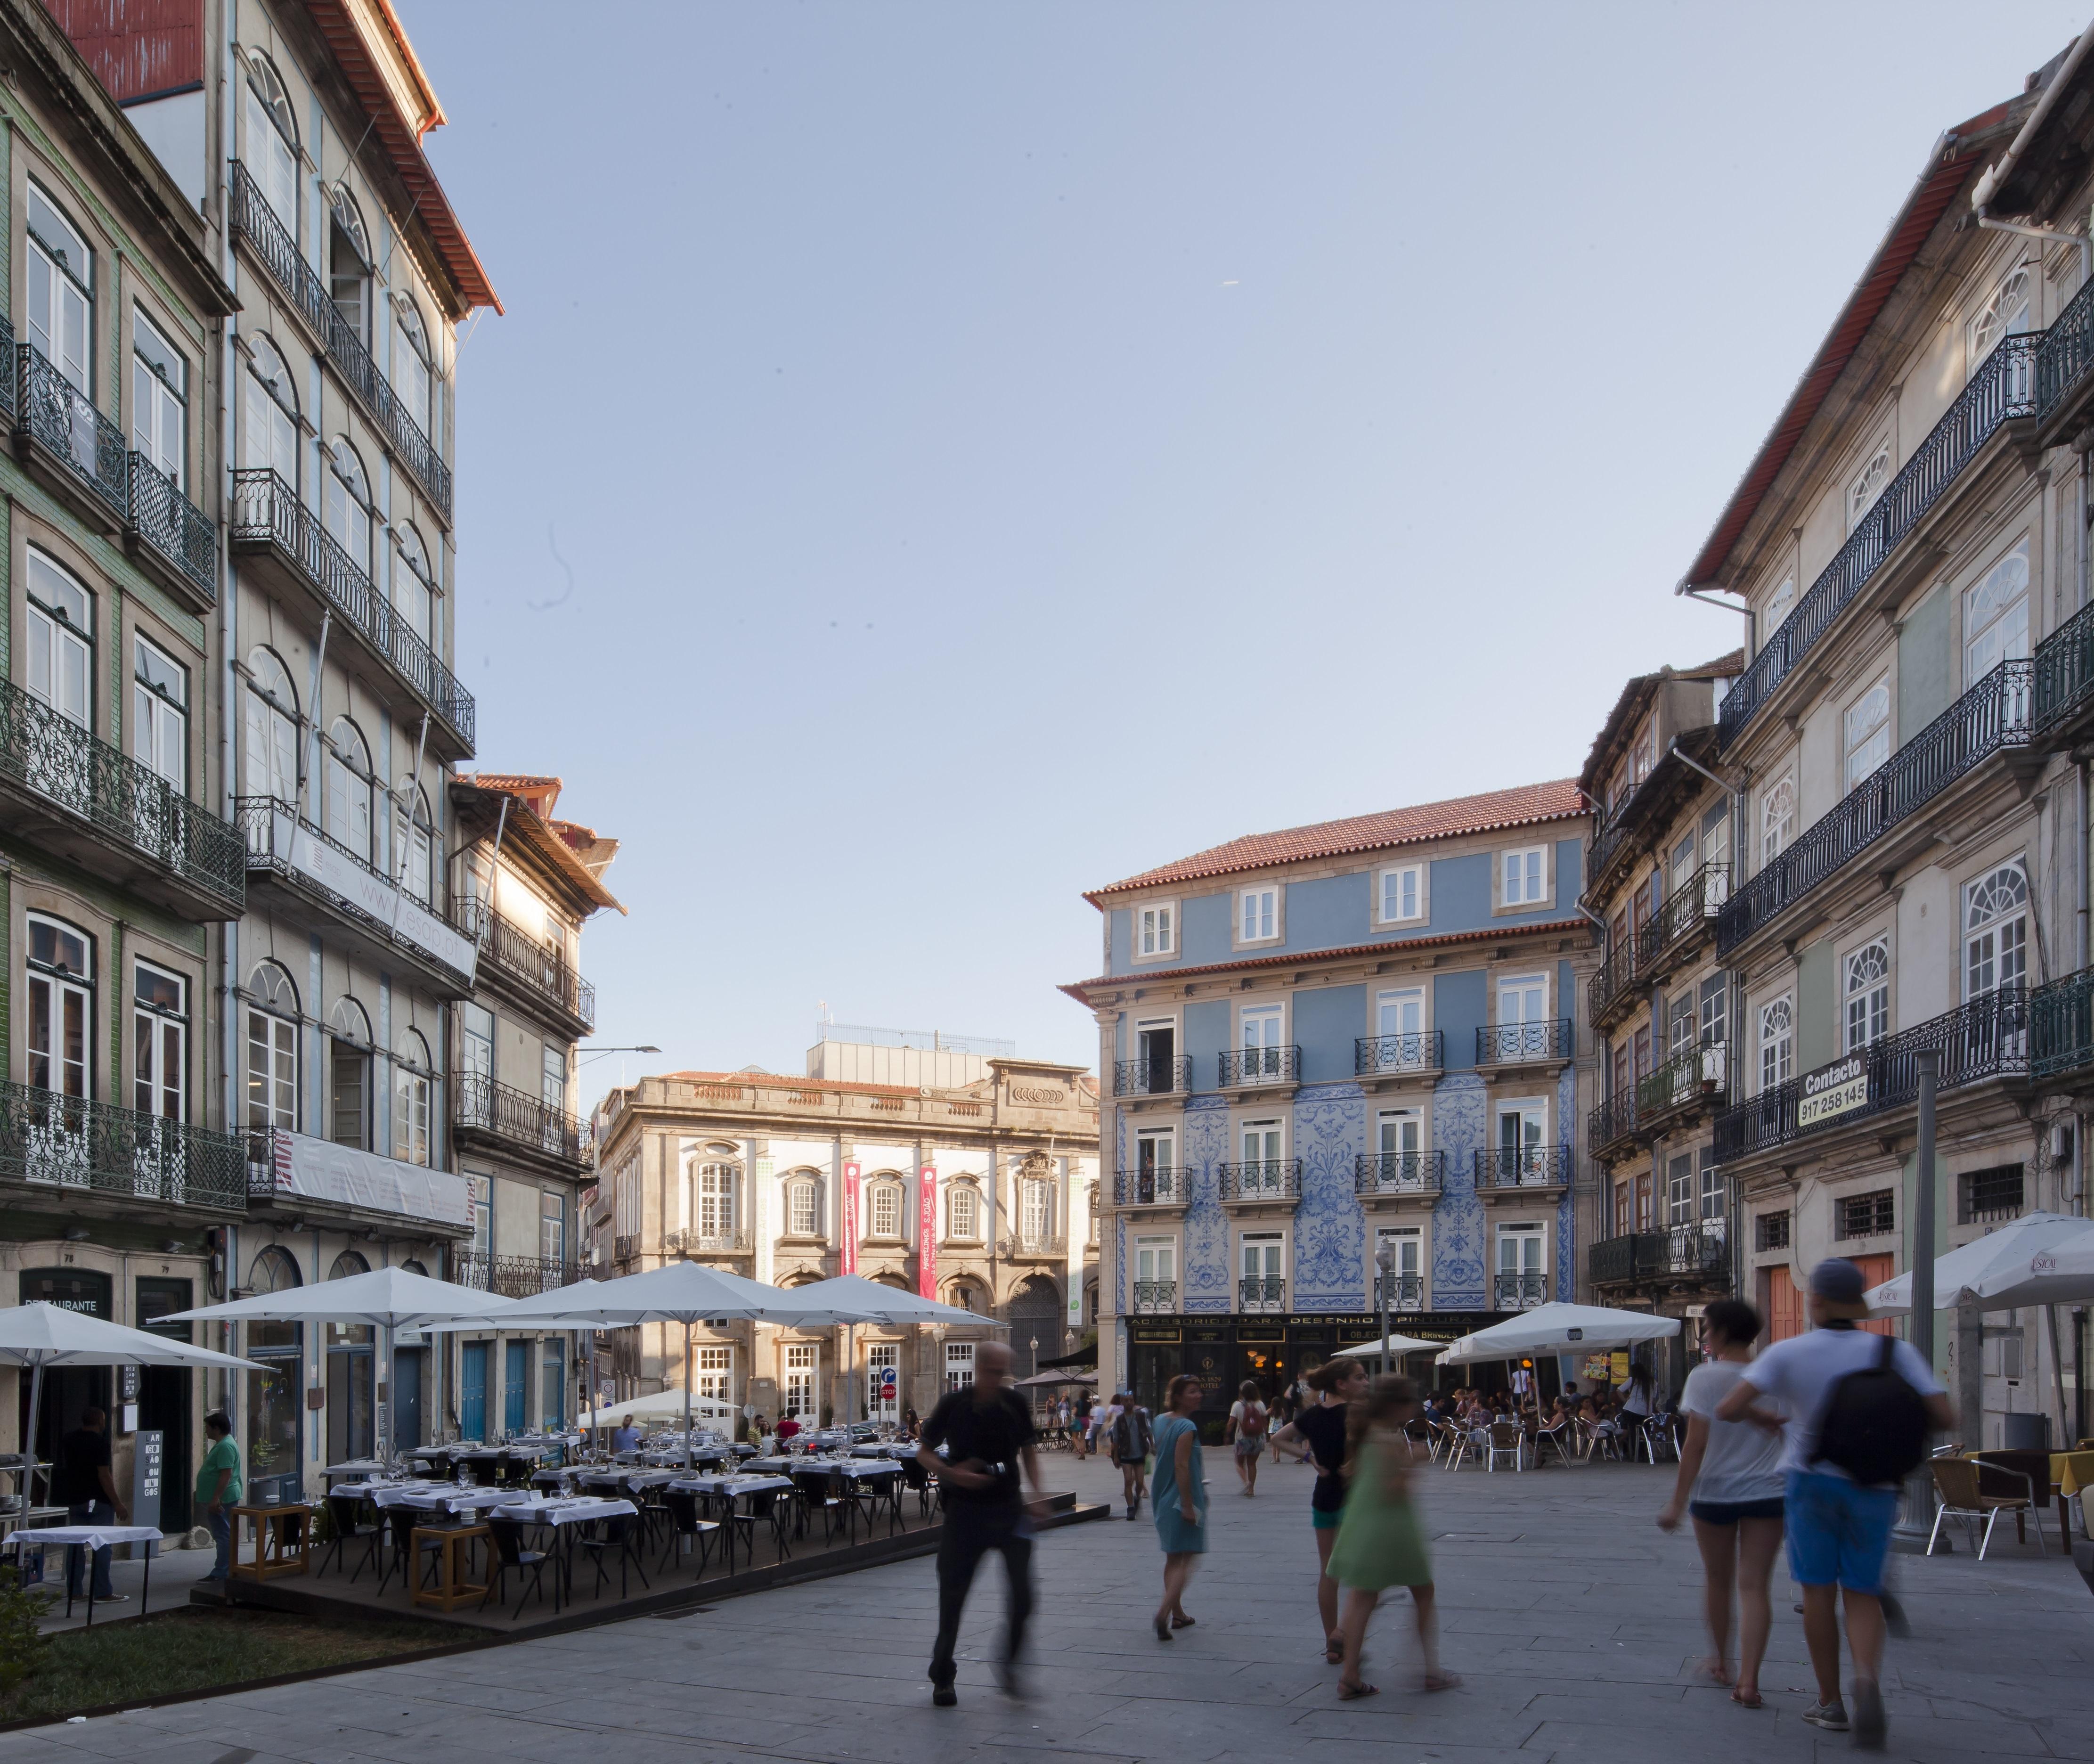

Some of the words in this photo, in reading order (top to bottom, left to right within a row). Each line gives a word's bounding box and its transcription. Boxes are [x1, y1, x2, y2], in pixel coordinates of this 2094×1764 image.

[1806, 1059, 1861, 1094] Contacto
[1802, 1100, 1818, 1120] 917
[1821, 1092, 1842, 1114] 258
[1844, 1082, 1865, 1105] 145
[1069, 1261, 1077, 1295] Palácio
[25, 1300, 97, 1311] RAURANTE
[145, 1468, 159, 1476] DOM
[144, 1487, 158, 1497] GOS
